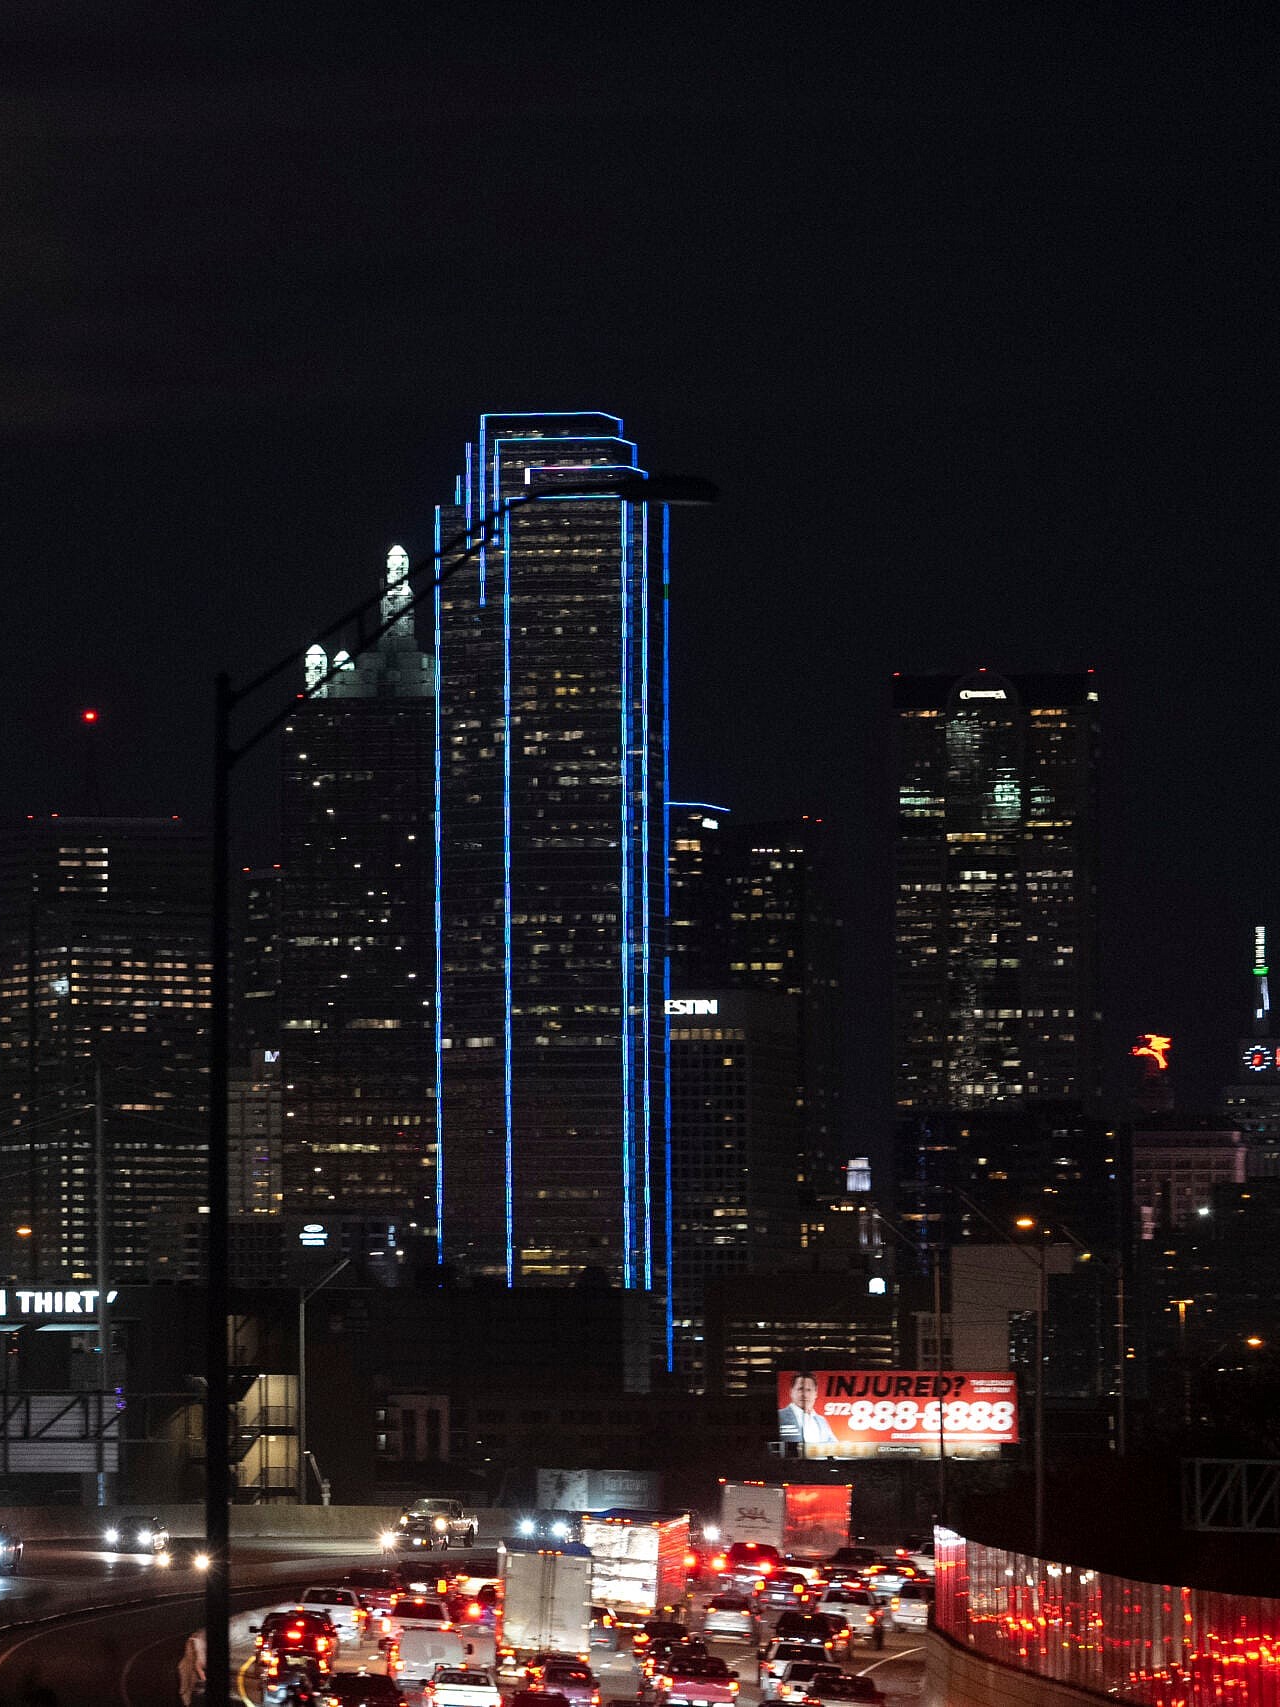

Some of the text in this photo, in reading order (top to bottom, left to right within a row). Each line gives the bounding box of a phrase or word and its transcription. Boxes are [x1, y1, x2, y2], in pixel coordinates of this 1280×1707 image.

[825, 1376, 966, 1397] INJURED?
[824, 1400, 1015, 1431] 972 888-8888
